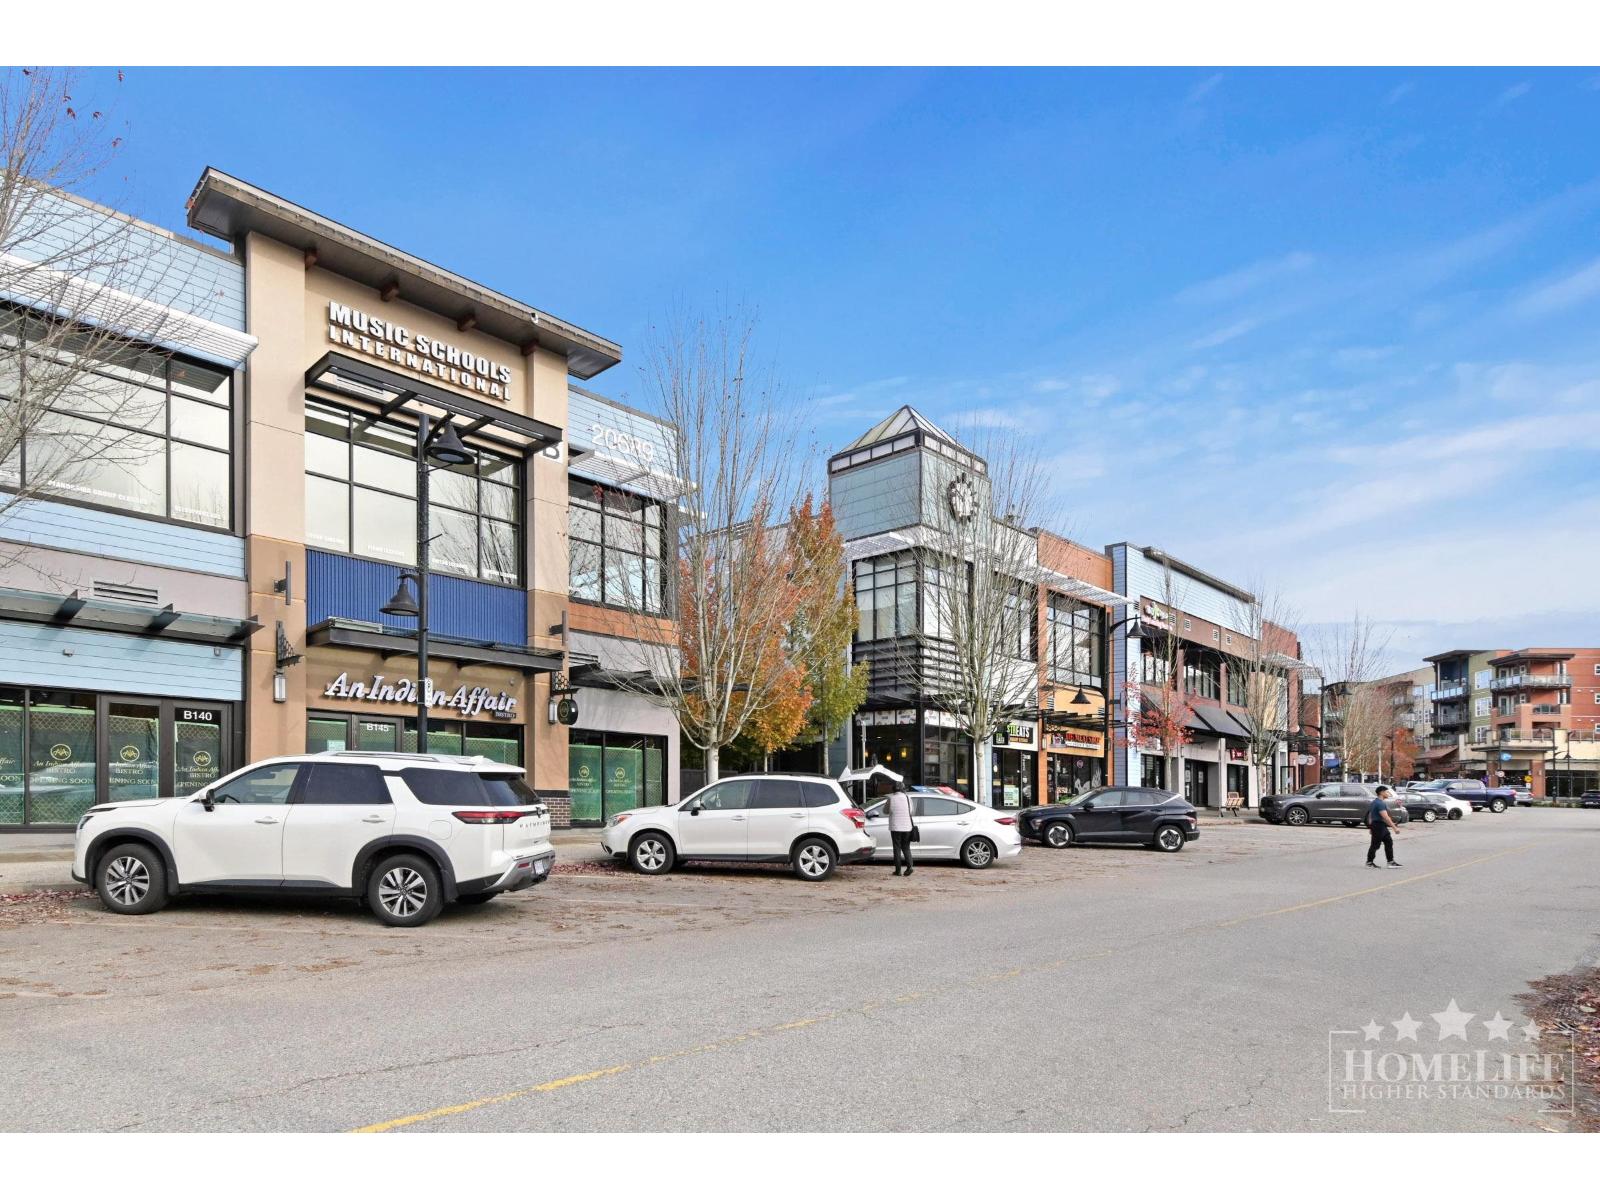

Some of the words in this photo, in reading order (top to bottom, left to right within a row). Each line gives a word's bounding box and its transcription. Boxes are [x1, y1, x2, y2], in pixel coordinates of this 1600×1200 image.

[329, 301, 409, 347] MUSIC
[415, 334, 513, 384] SCHOOLS
[328, 323, 512, 401] INTERNATIONAL
[325, 672, 365, 698] An
[366, 673, 447, 706] Indin
[448, 684, 518, 716] Affair
[183, 710, 213, 721] B140
[366, 722, 389, 732] B145
[0, 775, 21, 783] OON
